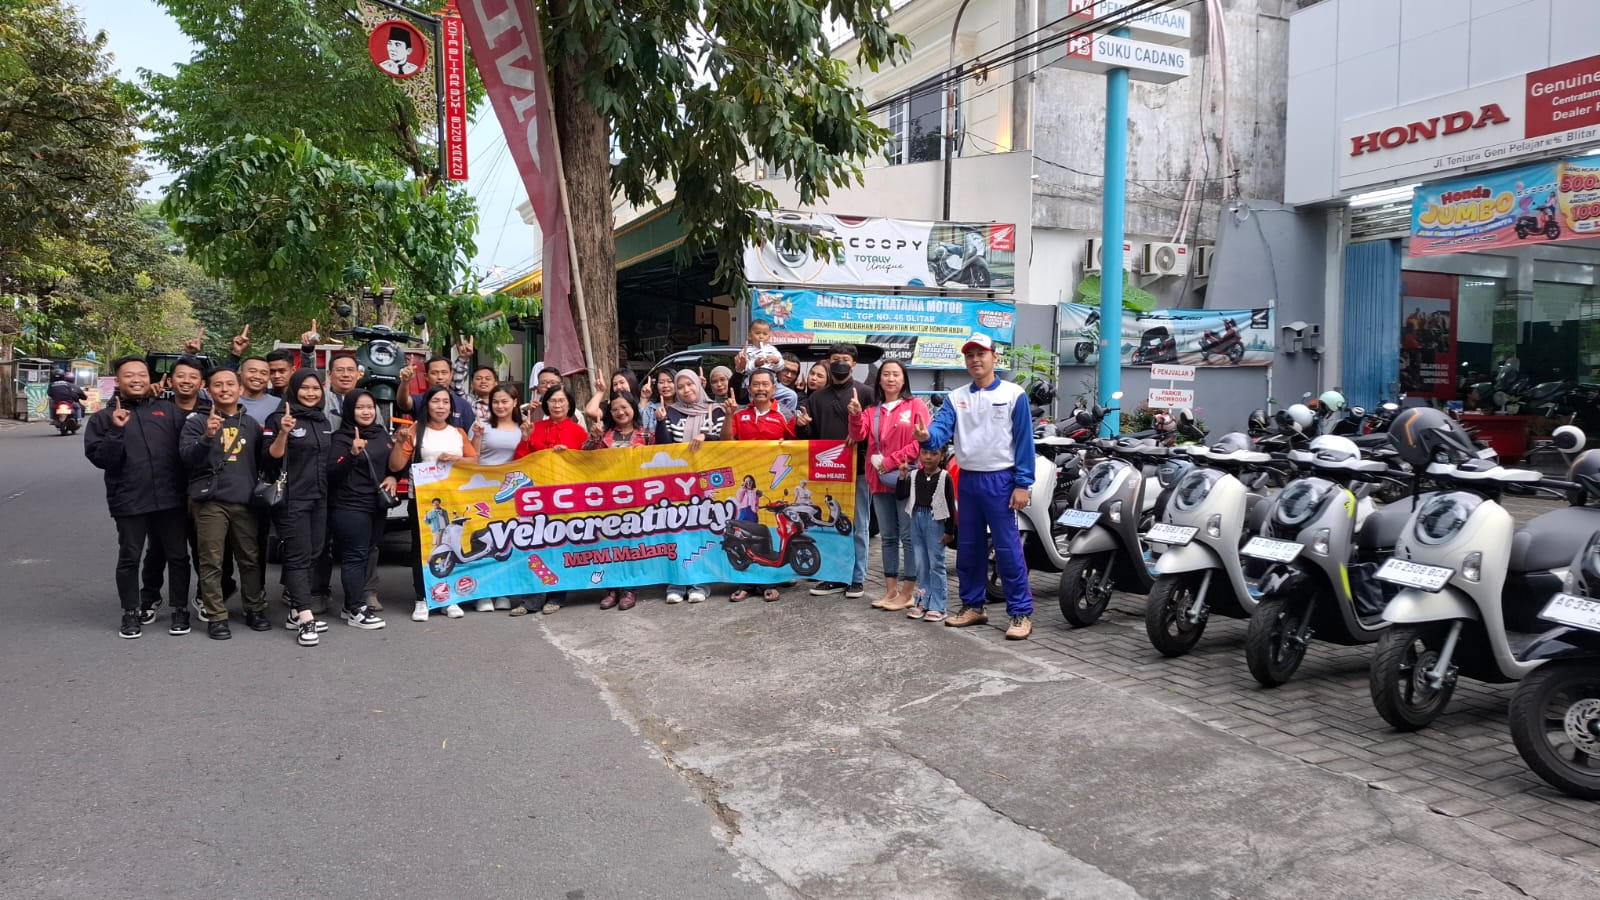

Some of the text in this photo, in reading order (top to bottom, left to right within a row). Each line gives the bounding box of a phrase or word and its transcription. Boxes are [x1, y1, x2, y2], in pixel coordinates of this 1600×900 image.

[1099, 41, 1184, 68] SUKU CADANG
[1531, 71, 1600, 97] Genuine
[447, 20, 464, 176] KOTA BLITAR BUMI BUNG KARNO
[1552, 106, 1592, 121] Dealer
[1350, 103, 1510, 156] HONDA
[1509, 140, 1544, 153] Pelajar
[1566, 128, 1598, 141] Blitar
[1441, 185, 1491, 205] Honda
[1419, 192, 1514, 225] JUMBO
[854, 254, 891, 264] TOTALLY
[866, 262, 905, 274] Unique
[855, 297, 924, 312] CENTRATAMA
[927, 301, 963, 314] MOTOR
[522, 477, 697, 512] SCOOPY
[488, 497, 738, 549] Velocreativity
[563, 543, 678, 567] MPM Malang
